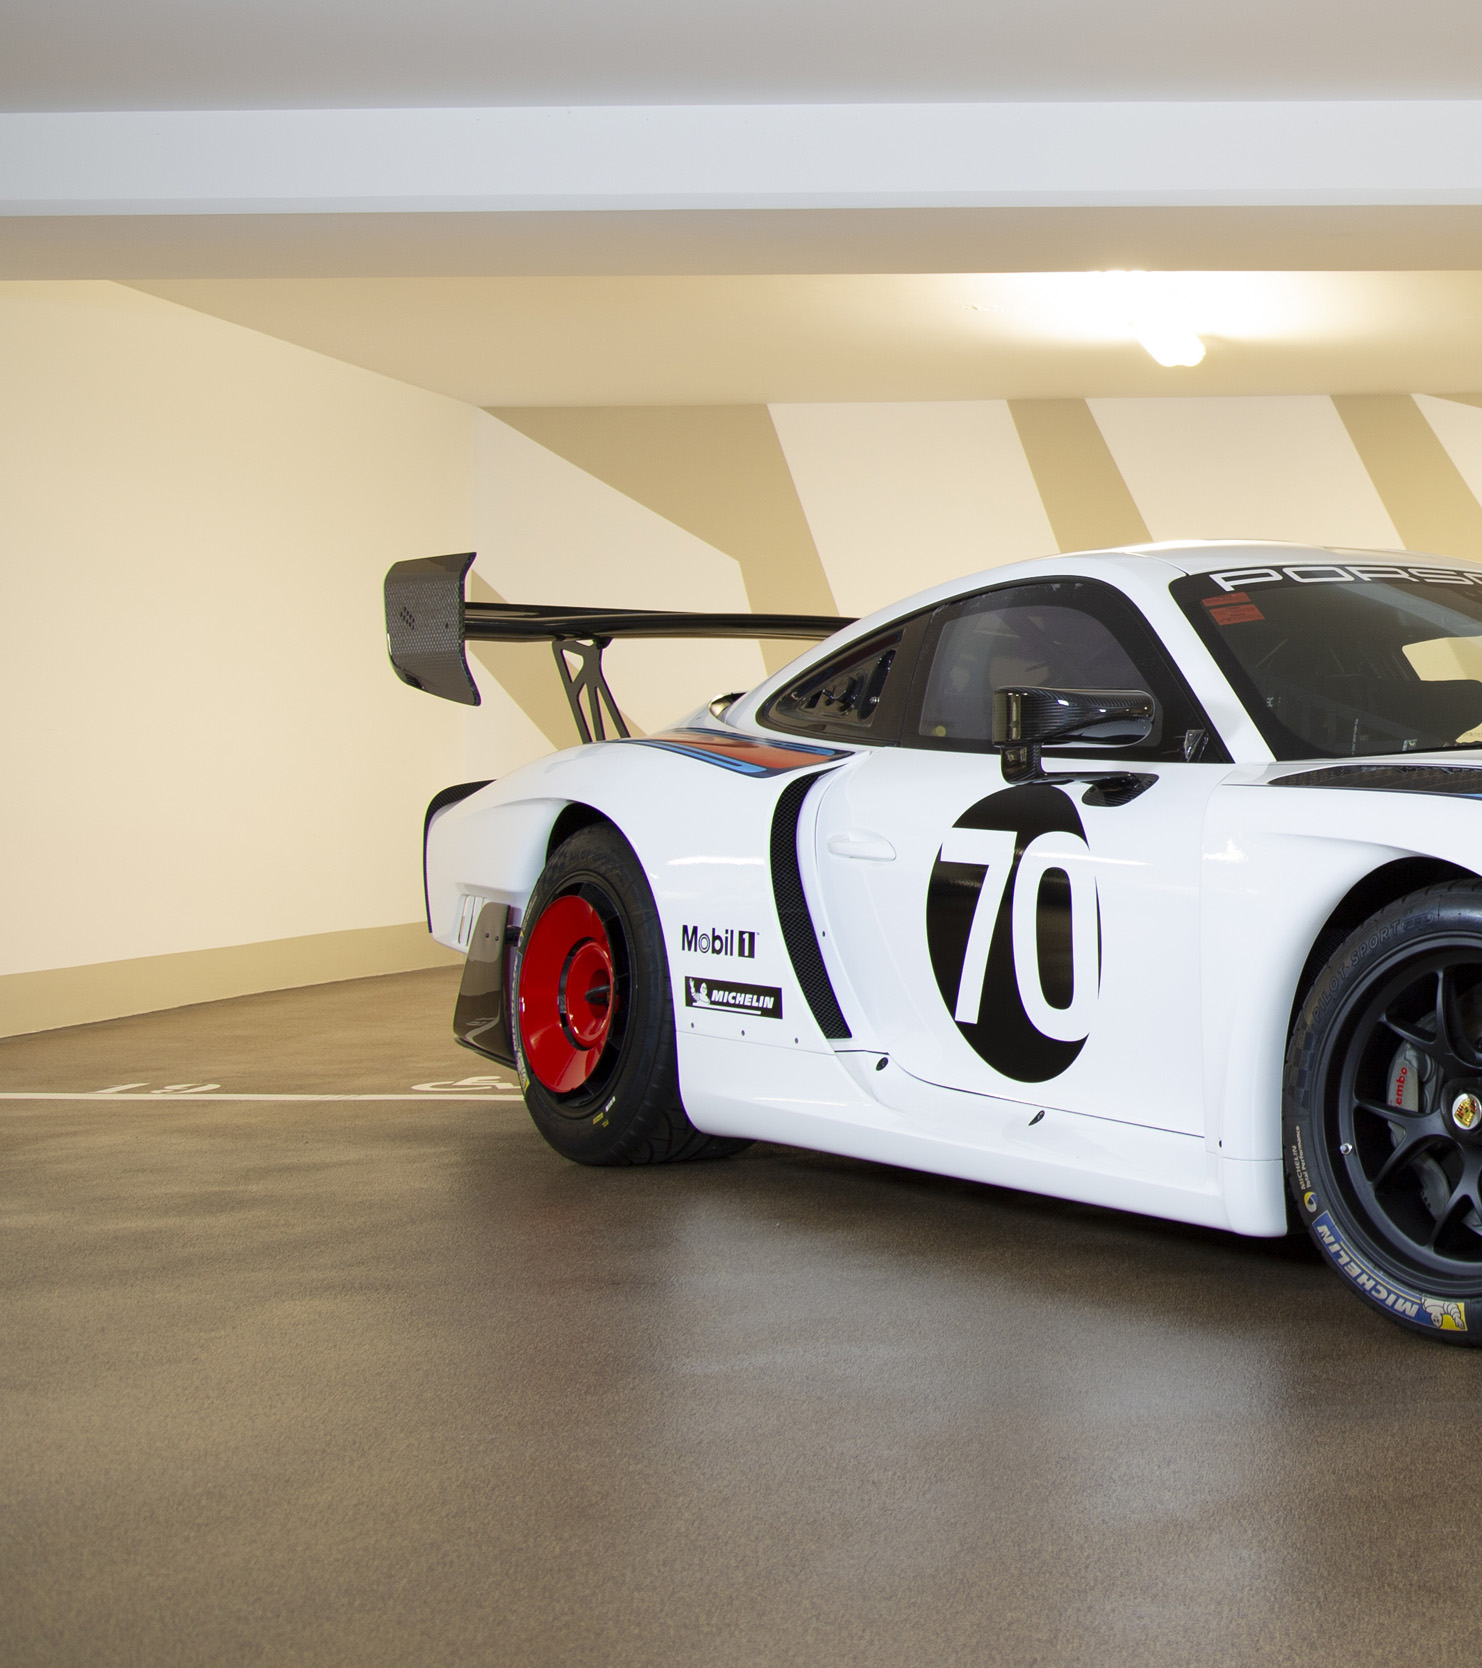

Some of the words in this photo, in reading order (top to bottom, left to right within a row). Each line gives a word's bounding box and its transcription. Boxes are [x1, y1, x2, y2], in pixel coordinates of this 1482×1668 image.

[682, 924, 734, 956] Mobil
[940, 827, 1098, 1042] 70
[1311, 963, 1349, 1023] PILOT
[1351, 920, 1402, 967] SPORT
[711, 989, 775, 1009] MICHELIN
[1394, 1066, 1408, 1108] embo
[1292, 1145, 1306, 1191] MICHELIN
[1296, 1124, 1307, 1171] Performance
[1303, 1171, 1312, 1189] Total
[1316, 1223, 1420, 1319] MICHELIN
